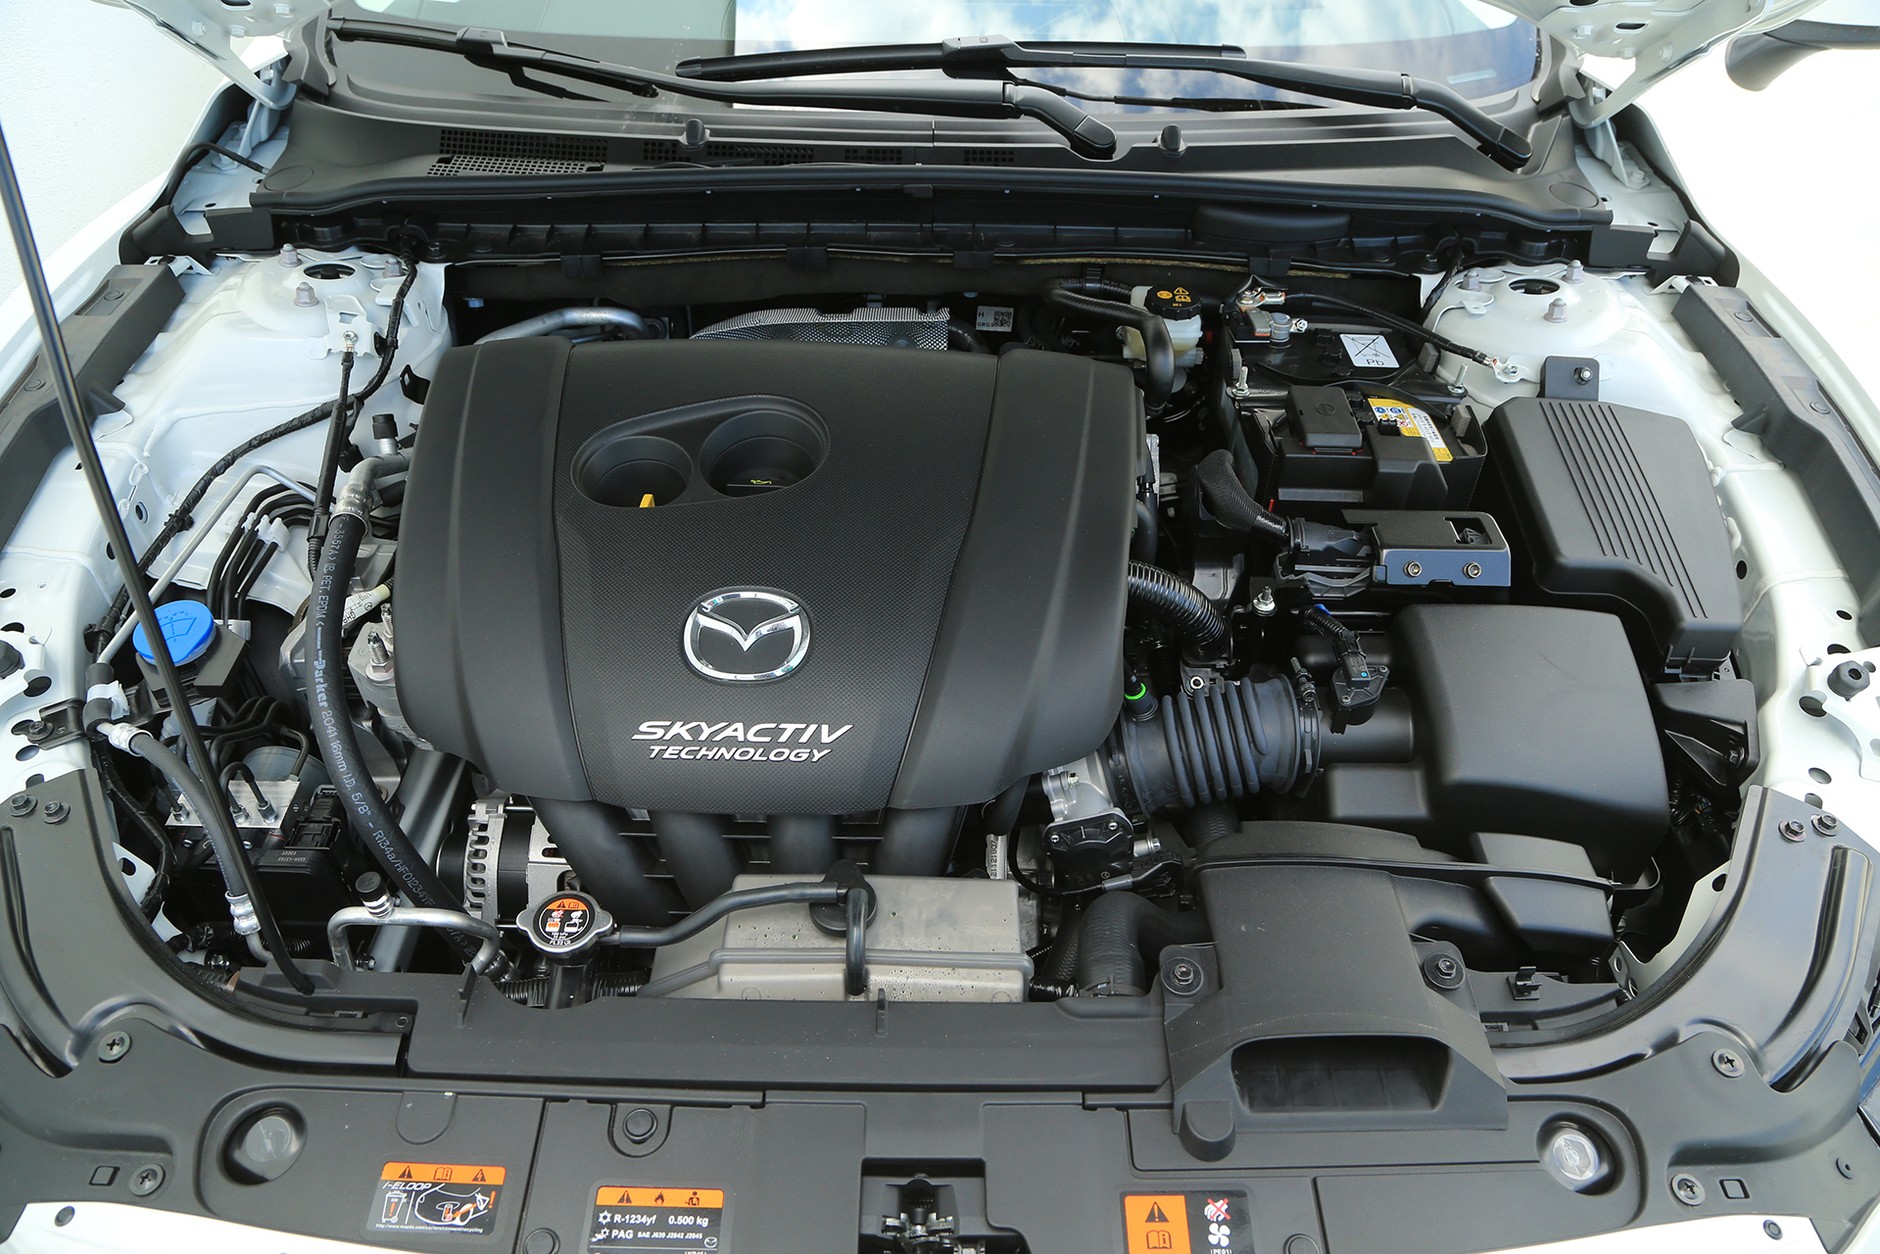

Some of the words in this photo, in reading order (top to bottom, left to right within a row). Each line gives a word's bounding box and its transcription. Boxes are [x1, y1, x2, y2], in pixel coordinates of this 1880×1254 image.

[313, 659, 329, 709] Parker
[321, 709, 338, 738] 2041
[330, 740, 347, 772] 16mm
[631, 721, 854, 744] SKYACTIV
[649, 745, 832, 763] TECHNOLOGY
[613, 1213, 657, 1226] R-1234yf
[668, 1215, 695, 1226] 0.500
[696, 1216, 709, 1228] kg
[611, 1229, 634, 1239] PAG
[637, 1231, 651, 1239] SAE
